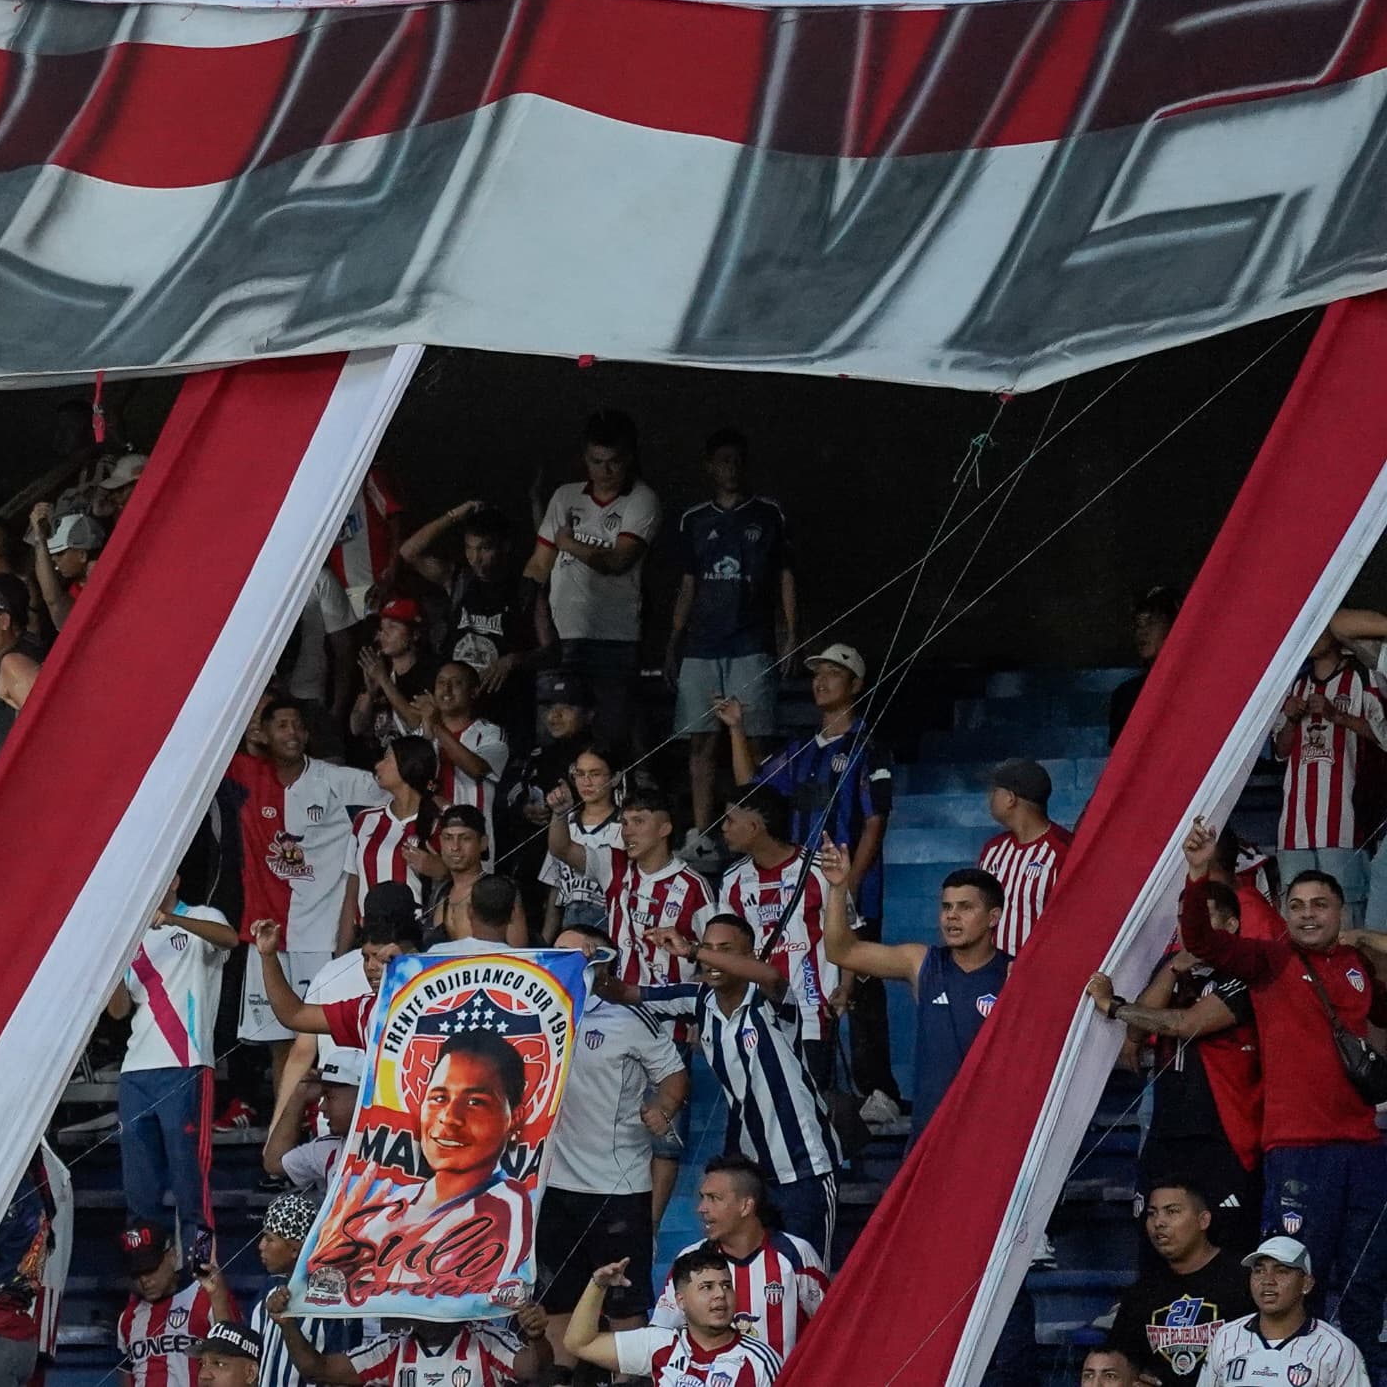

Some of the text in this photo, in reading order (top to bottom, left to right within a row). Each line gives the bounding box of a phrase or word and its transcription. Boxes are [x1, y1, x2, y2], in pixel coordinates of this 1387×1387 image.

[383, 992, 429, 1056] FRENTE
[423, 967, 526, 1001] ROJIBLANCO
[523, 980, 555, 1014] SUR
[1165, 1297, 1204, 1327] 27
[1227, 1358, 1247, 1382] 10
